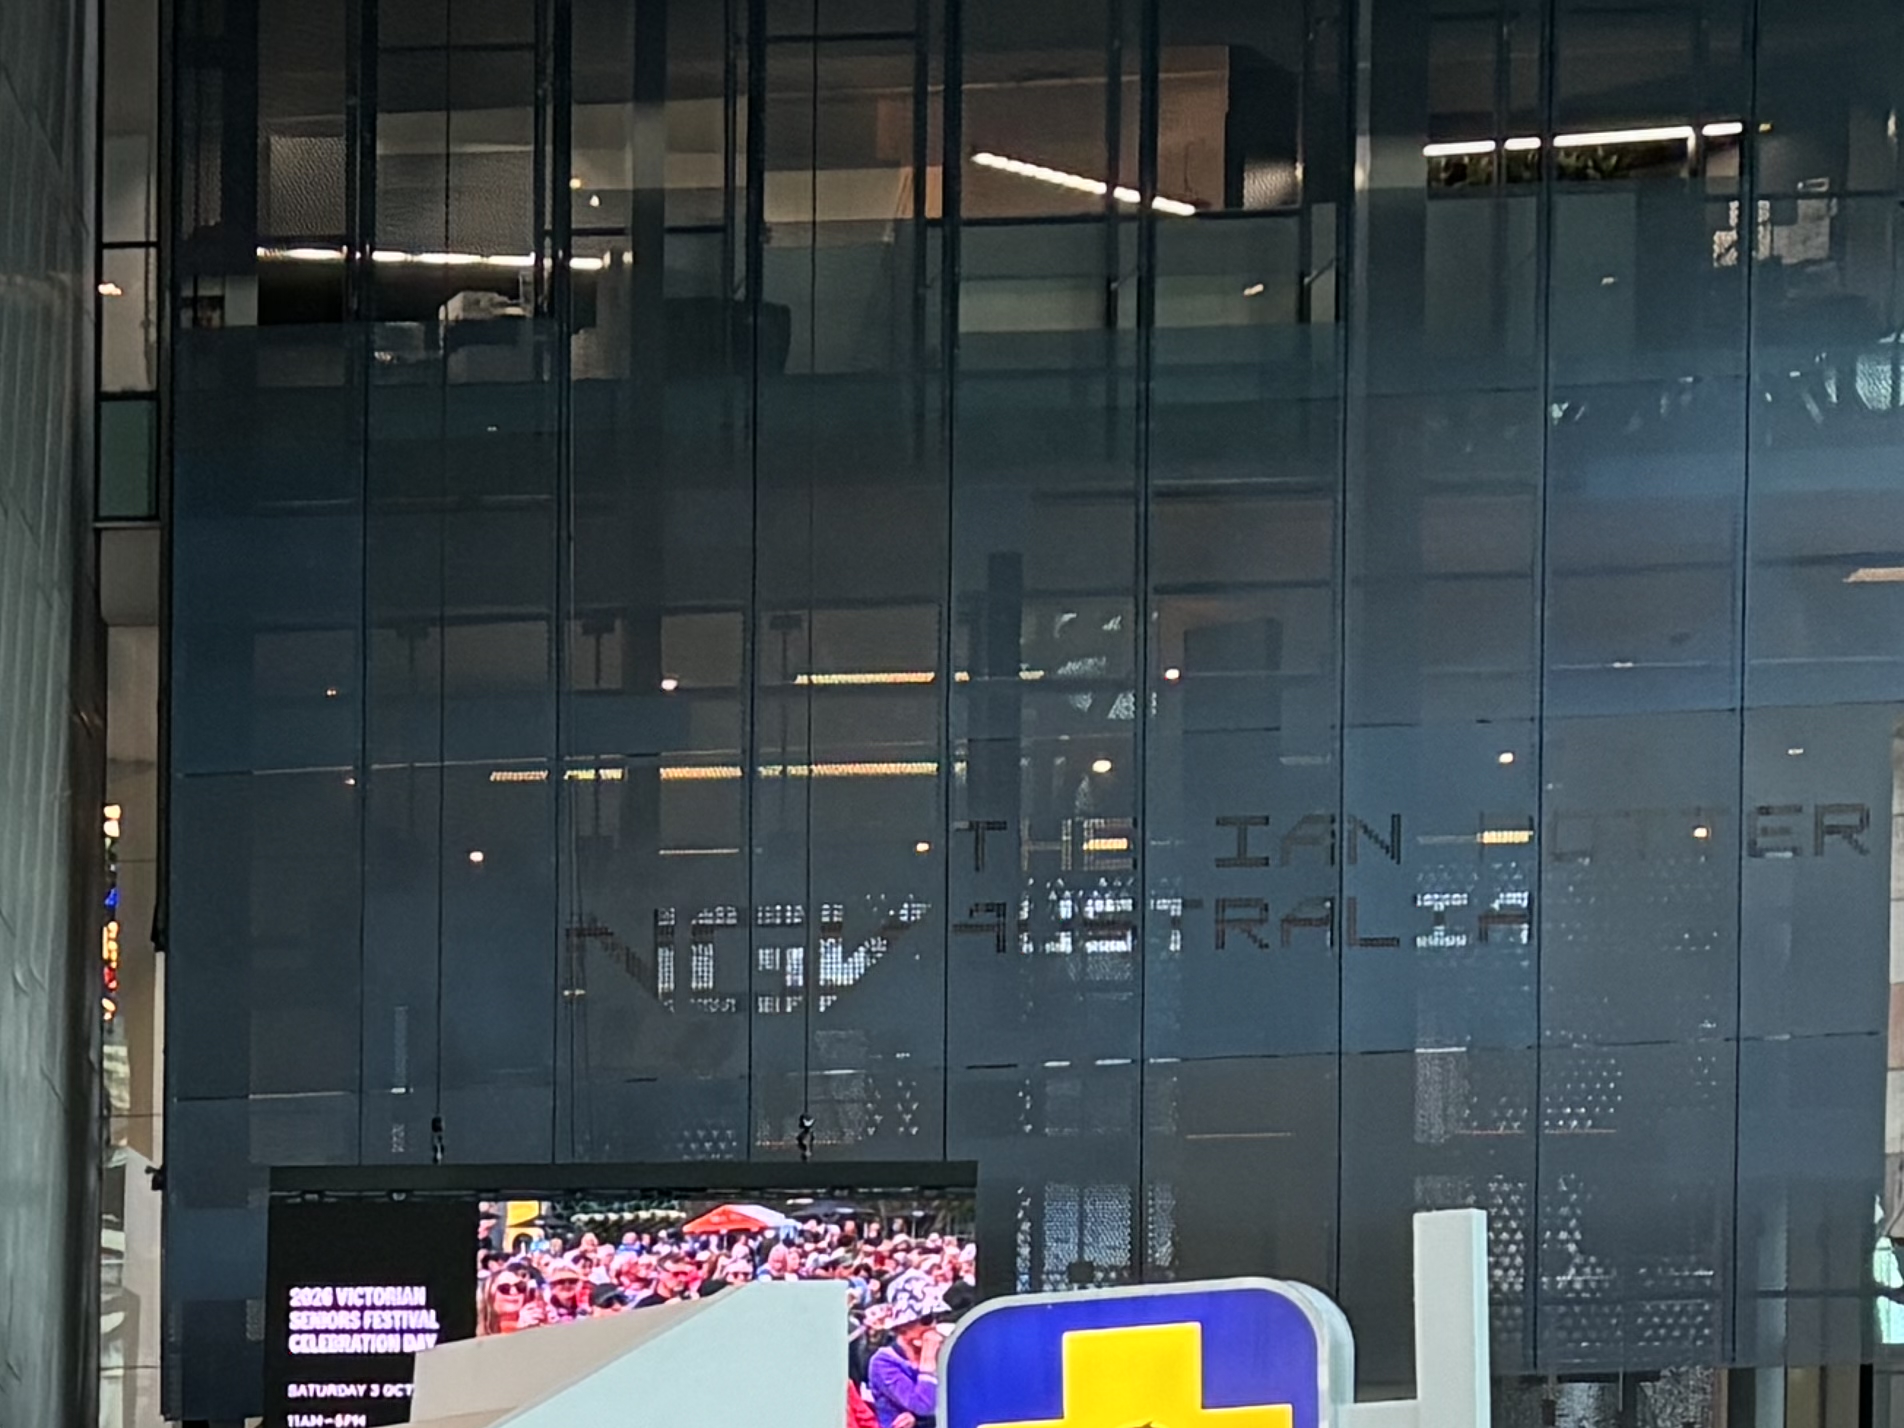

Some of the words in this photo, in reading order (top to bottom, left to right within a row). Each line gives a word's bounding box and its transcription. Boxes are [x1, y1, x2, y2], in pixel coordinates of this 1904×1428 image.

[952, 816, 1138, 874] THE
[1214, 812, 1402, 869] IAN
[335, 1286, 427, 1307] VICTORIAN
[289, 1310, 362, 1331] SENIORS
[363, 1309, 440, 1331] FESTIVAL
[288, 1333, 401, 1354] CELEBRATION
[402, 1333, 439, 1353] DAY
[287, 1383, 367, 1398] SATURDAY
